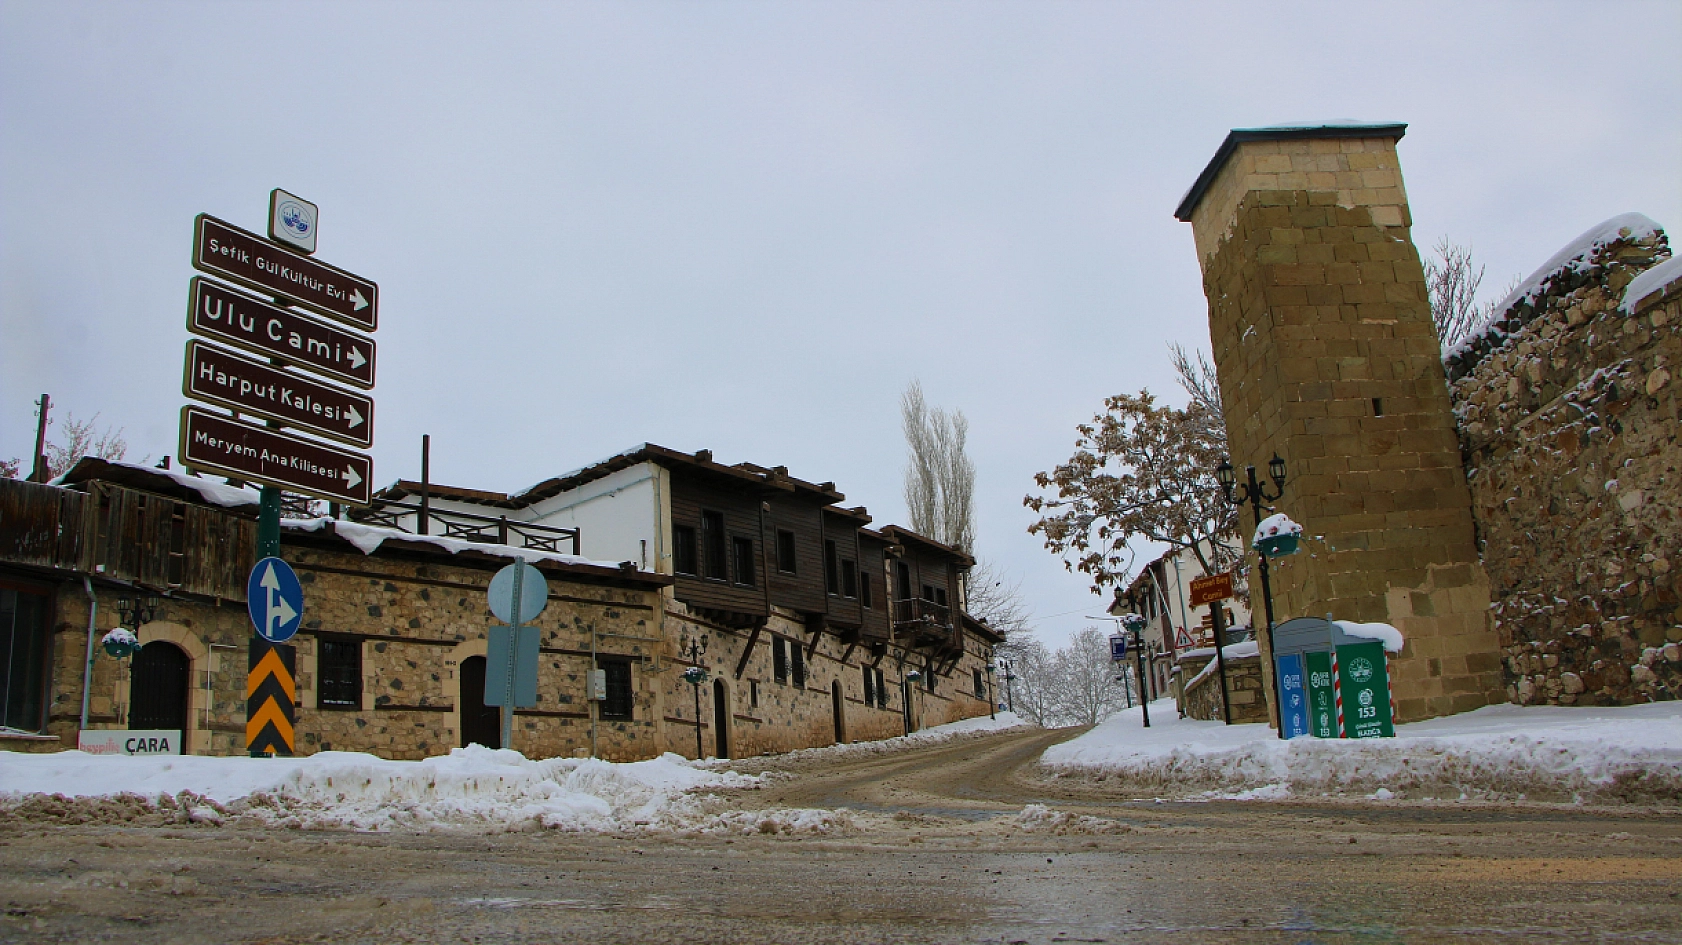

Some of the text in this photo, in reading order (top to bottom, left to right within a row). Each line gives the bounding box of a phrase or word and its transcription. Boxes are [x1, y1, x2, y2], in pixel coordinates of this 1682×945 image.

[208, 239, 346, 301] Şefik Gül Kültür Evi
[204, 294, 341, 362] Ulu Cami
[200, 361, 340, 421] Harput Kalesi
[195, 430, 338, 480] Meryem Ana Kilisesi
[1357, 707, 1376, 718] 153
[125, 737, 170, 755] ÇARA
